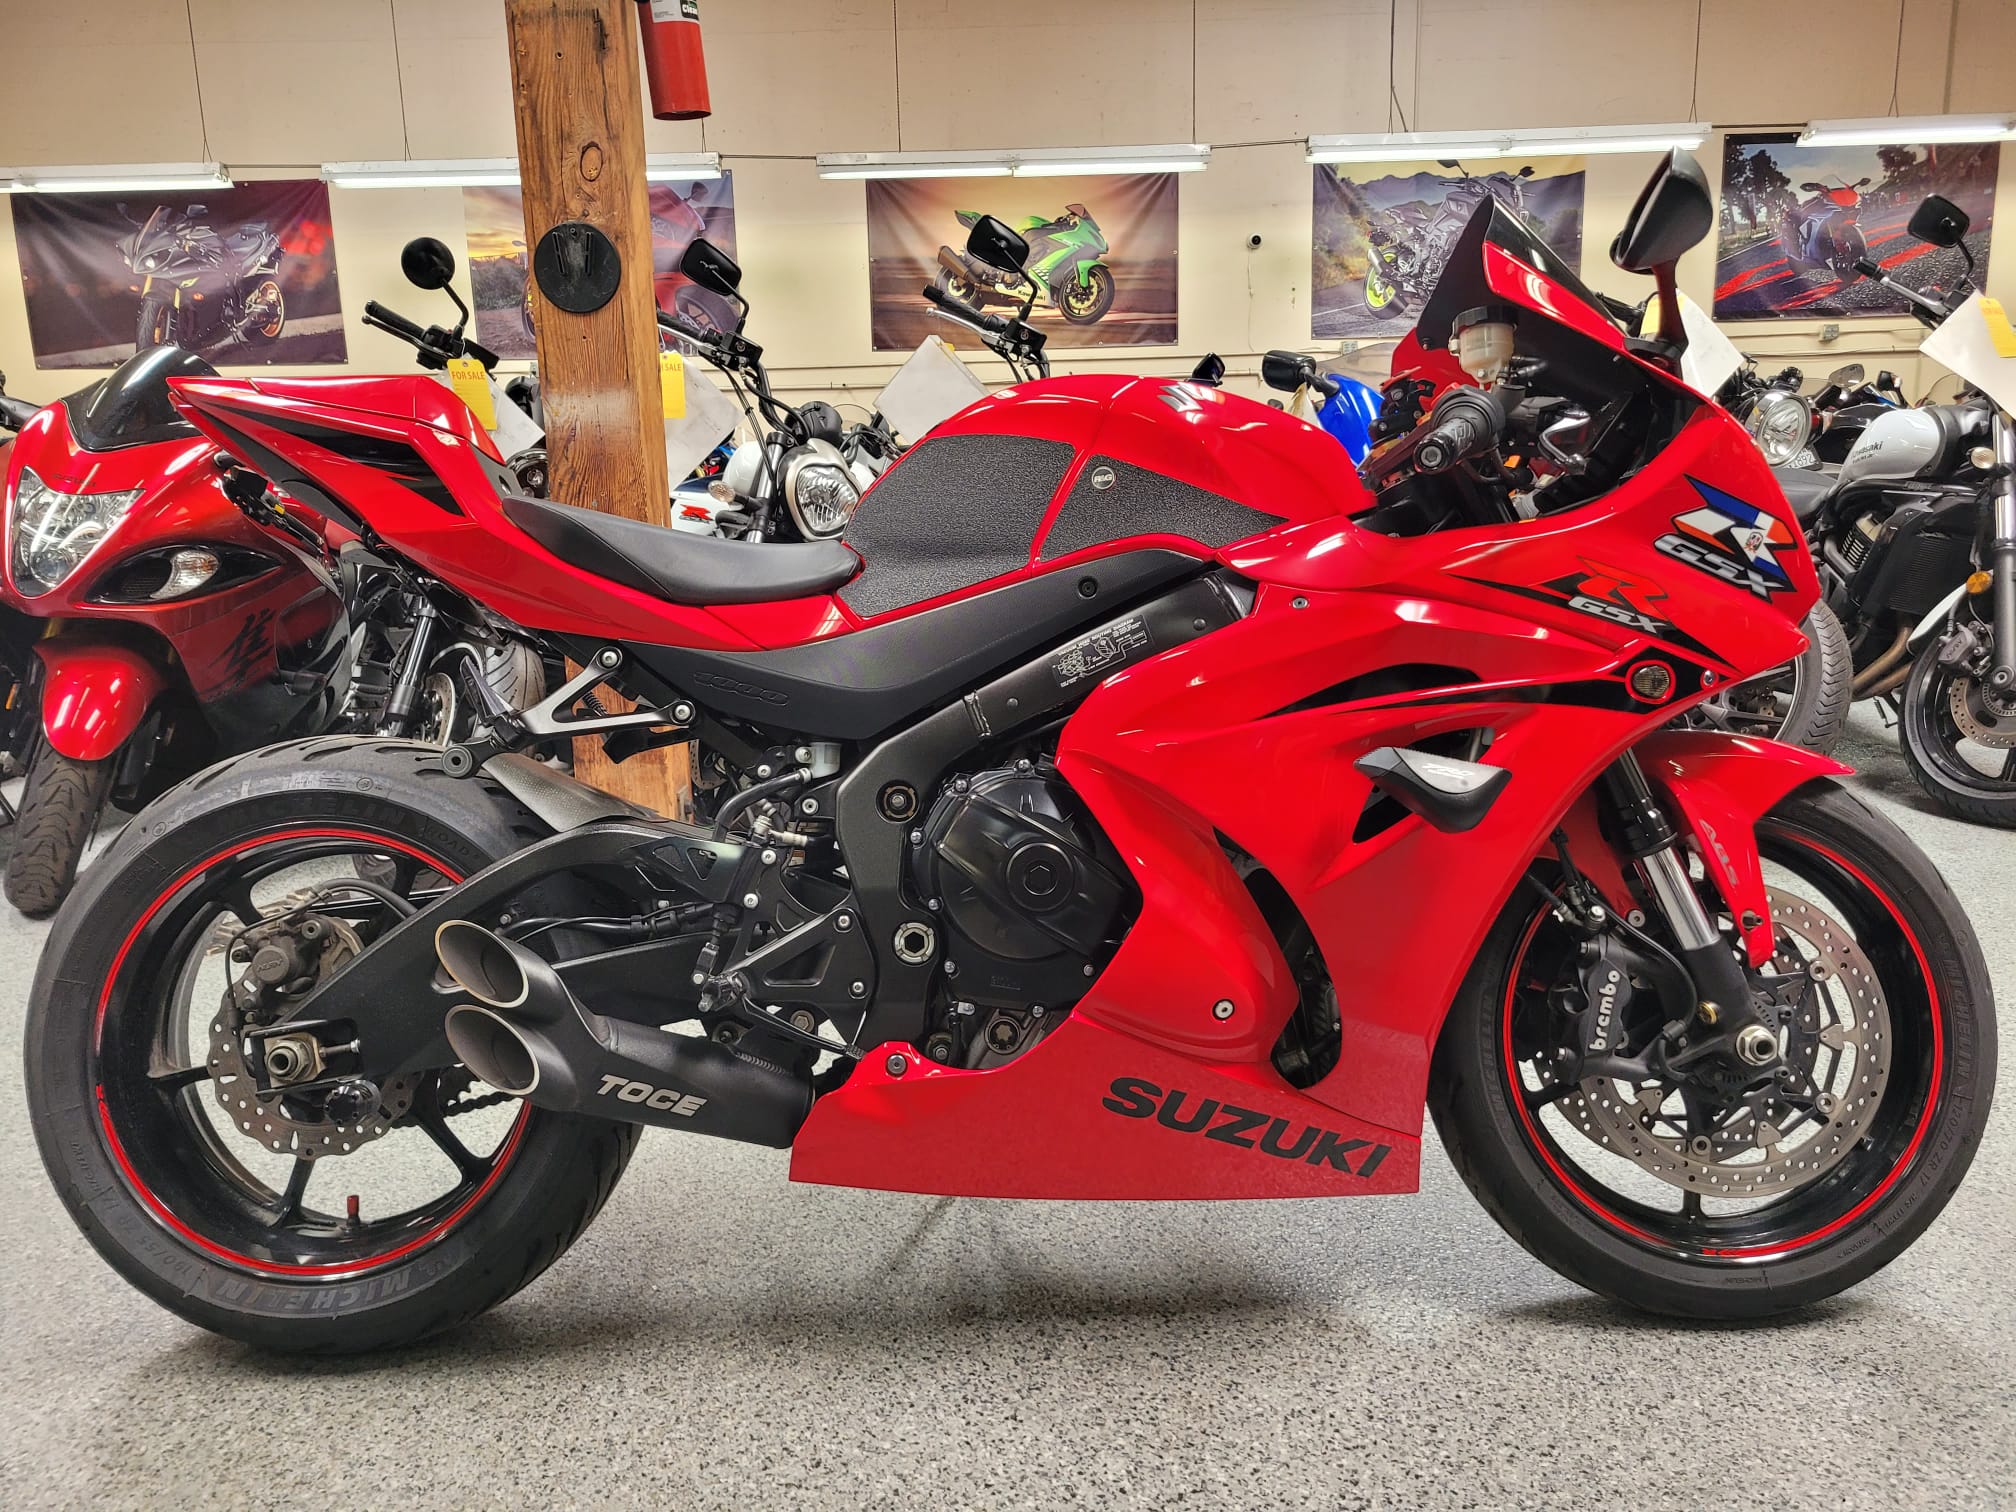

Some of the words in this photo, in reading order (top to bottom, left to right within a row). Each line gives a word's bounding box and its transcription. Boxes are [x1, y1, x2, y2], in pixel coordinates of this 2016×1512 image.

[451, 371, 467, 381] FOR
[468, 371, 486, 380] SALE
[1653, 534, 1785, 598] GSX
[1568, 596, 1667, 634] GSX
[1698, 818, 1738, 889] ABS
[1588, 970, 1620, 1050] brembo
[1942, 958, 1973, 1080] MICHELIN
[596, 1073, 708, 1117] TOCE
[1101, 1076, 1393, 1179] SUZUKI
[1940, 1102, 1963, 1151] 120/70
[215, 1273, 411, 1313] MICHELIN
